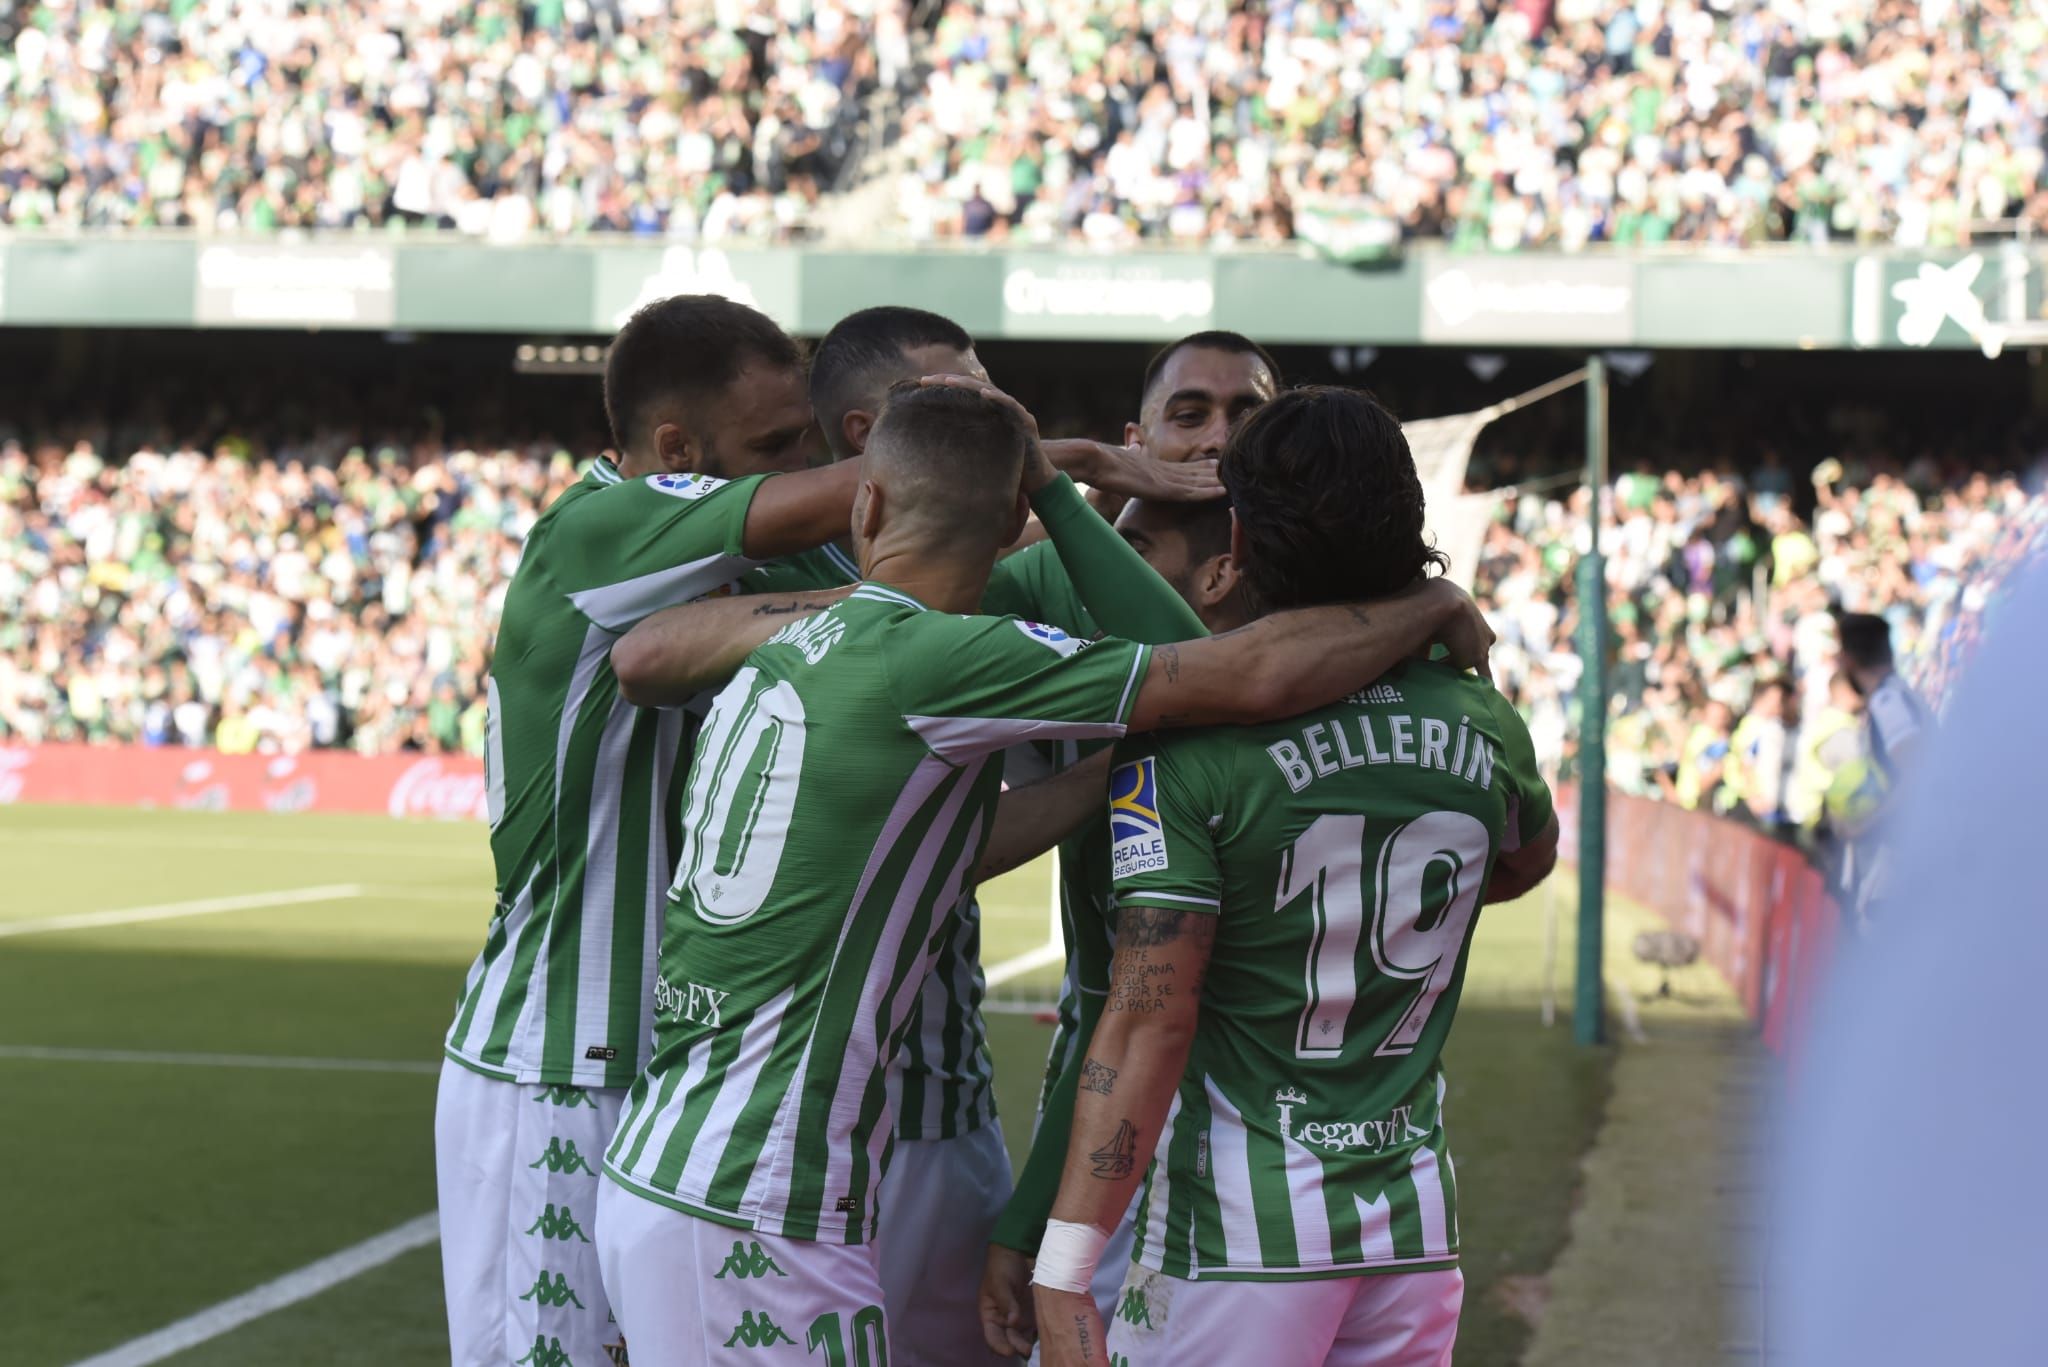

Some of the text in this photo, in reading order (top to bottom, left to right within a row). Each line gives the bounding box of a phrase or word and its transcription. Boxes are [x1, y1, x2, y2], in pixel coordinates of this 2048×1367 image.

[1265, 714, 1495, 794] BELLERÍN
[666, 666, 807, 926] 10
[1113, 839, 1164, 865] REALE
[1114, 856, 1165, 877] SEGUROS
[1273, 810, 1490, 1059] 19
[1138, 962, 1176, 977] GANA
[1157, 984, 1176, 997] SE
[1108, 998, 1165, 1014] LO PASA
[1275, 1103, 1432, 1154] LegacyFX
